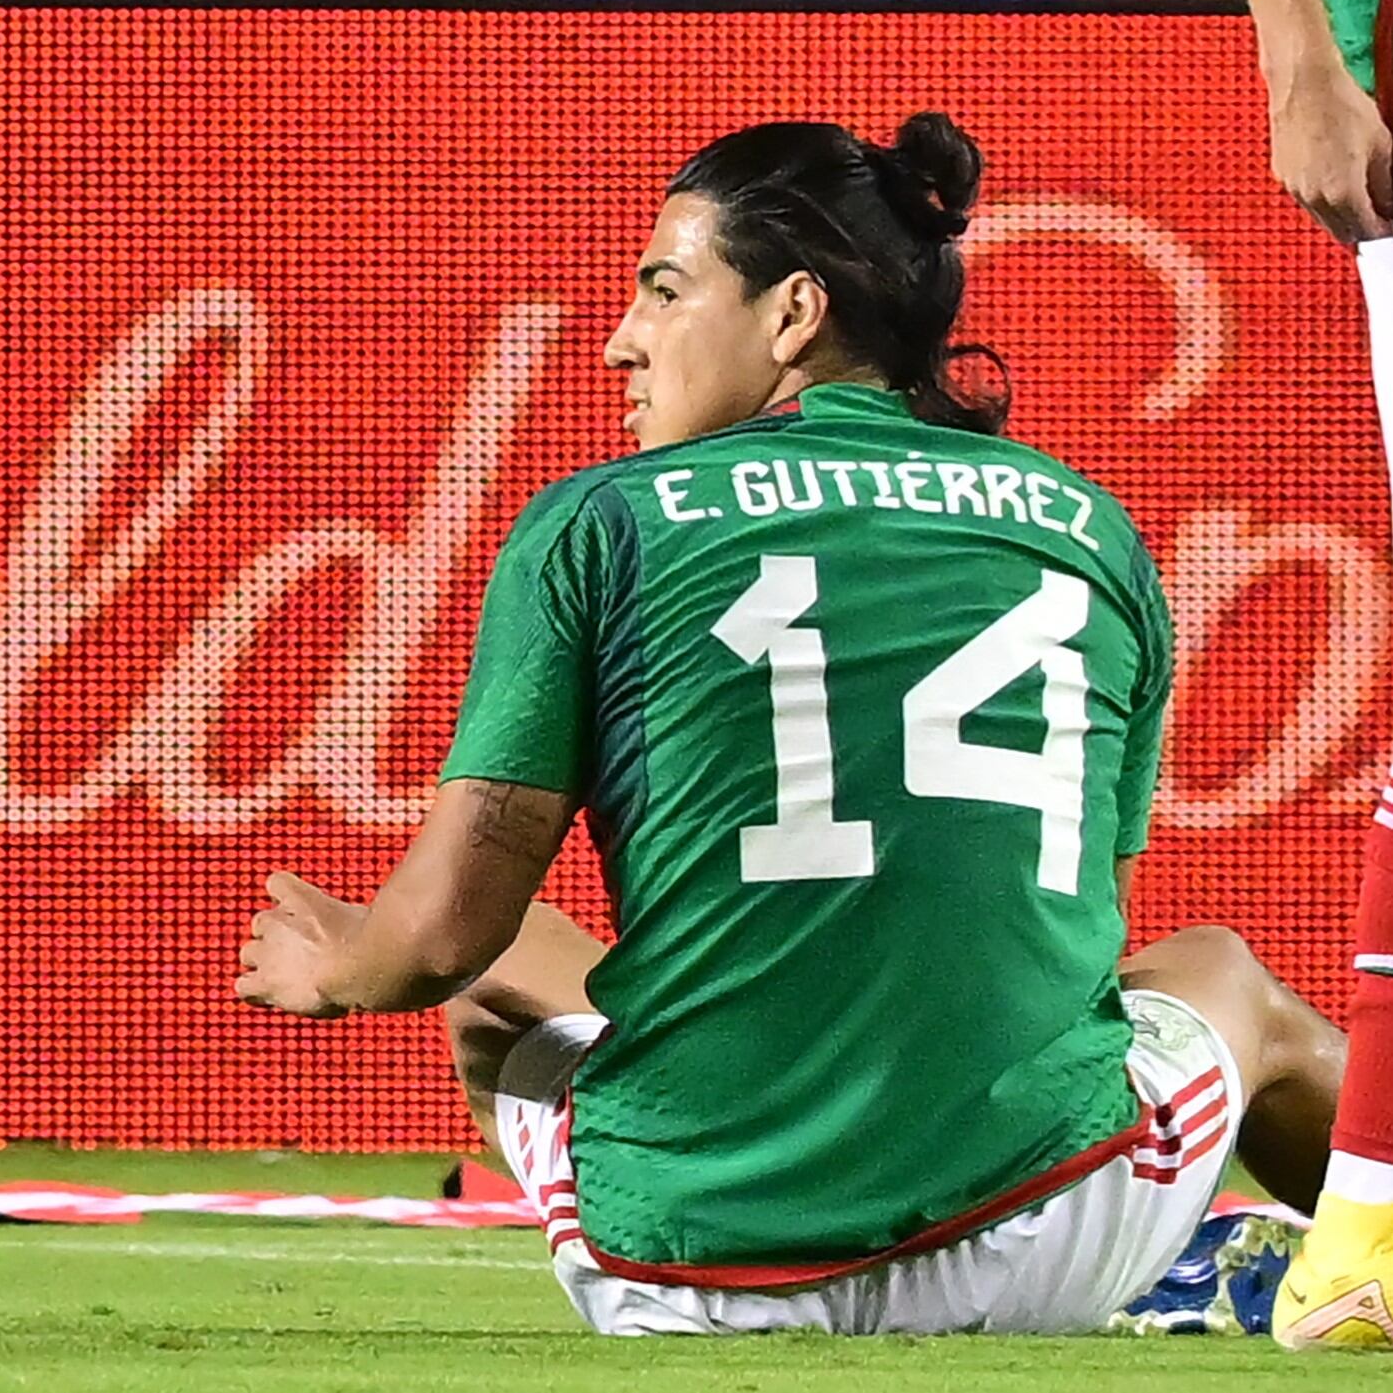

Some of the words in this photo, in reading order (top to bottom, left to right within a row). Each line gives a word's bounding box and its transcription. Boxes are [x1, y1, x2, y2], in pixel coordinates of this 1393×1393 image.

[652, 469, 722, 522] E.
[730, 451, 1100, 551] GUTIÉRREZ
[710, 554, 1091, 896] 14
